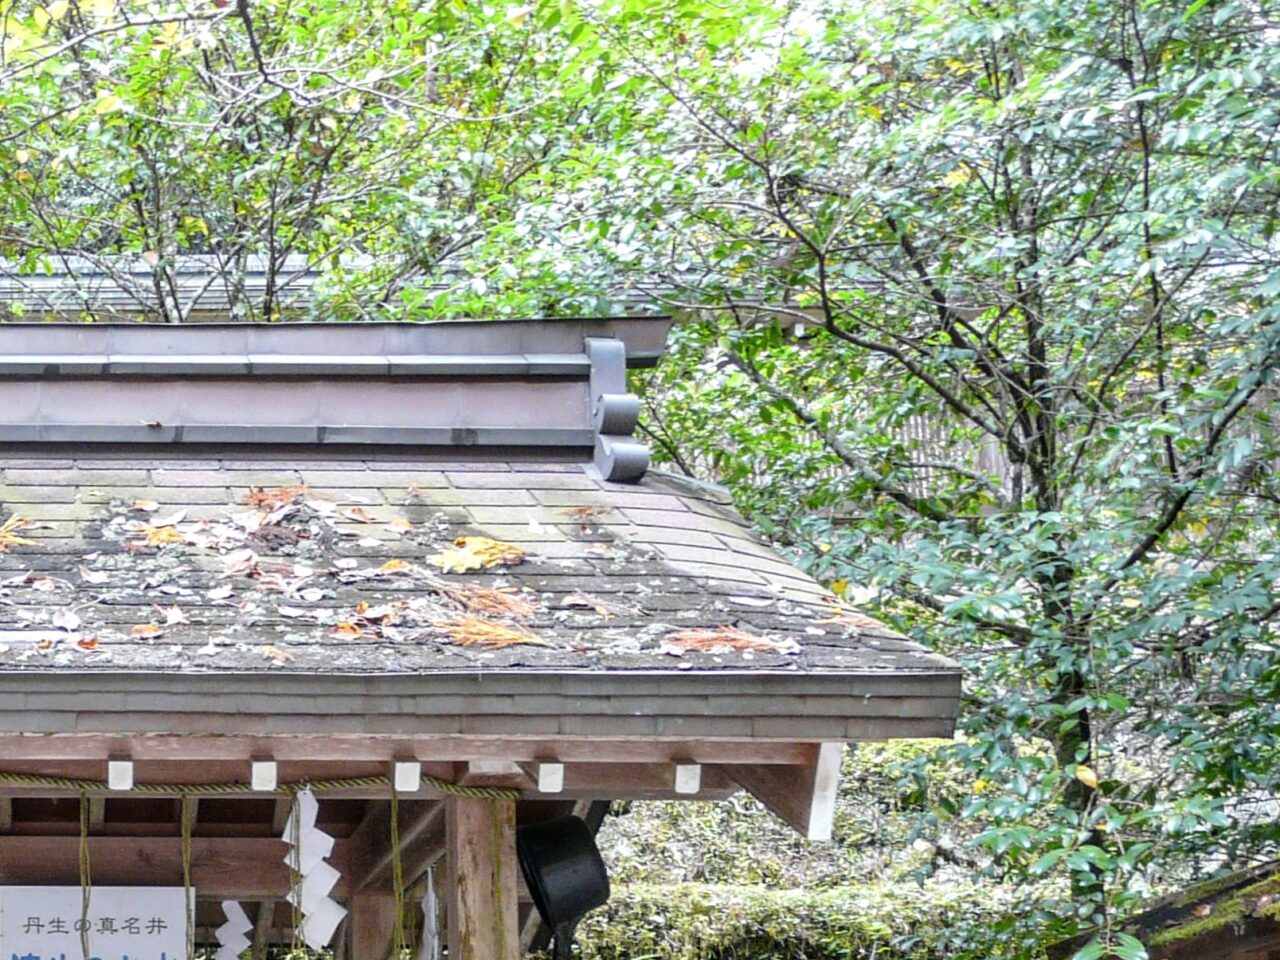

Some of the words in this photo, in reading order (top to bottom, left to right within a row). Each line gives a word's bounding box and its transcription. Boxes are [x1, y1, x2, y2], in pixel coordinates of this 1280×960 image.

[22, 916, 168, 935] 丹生の真名井
